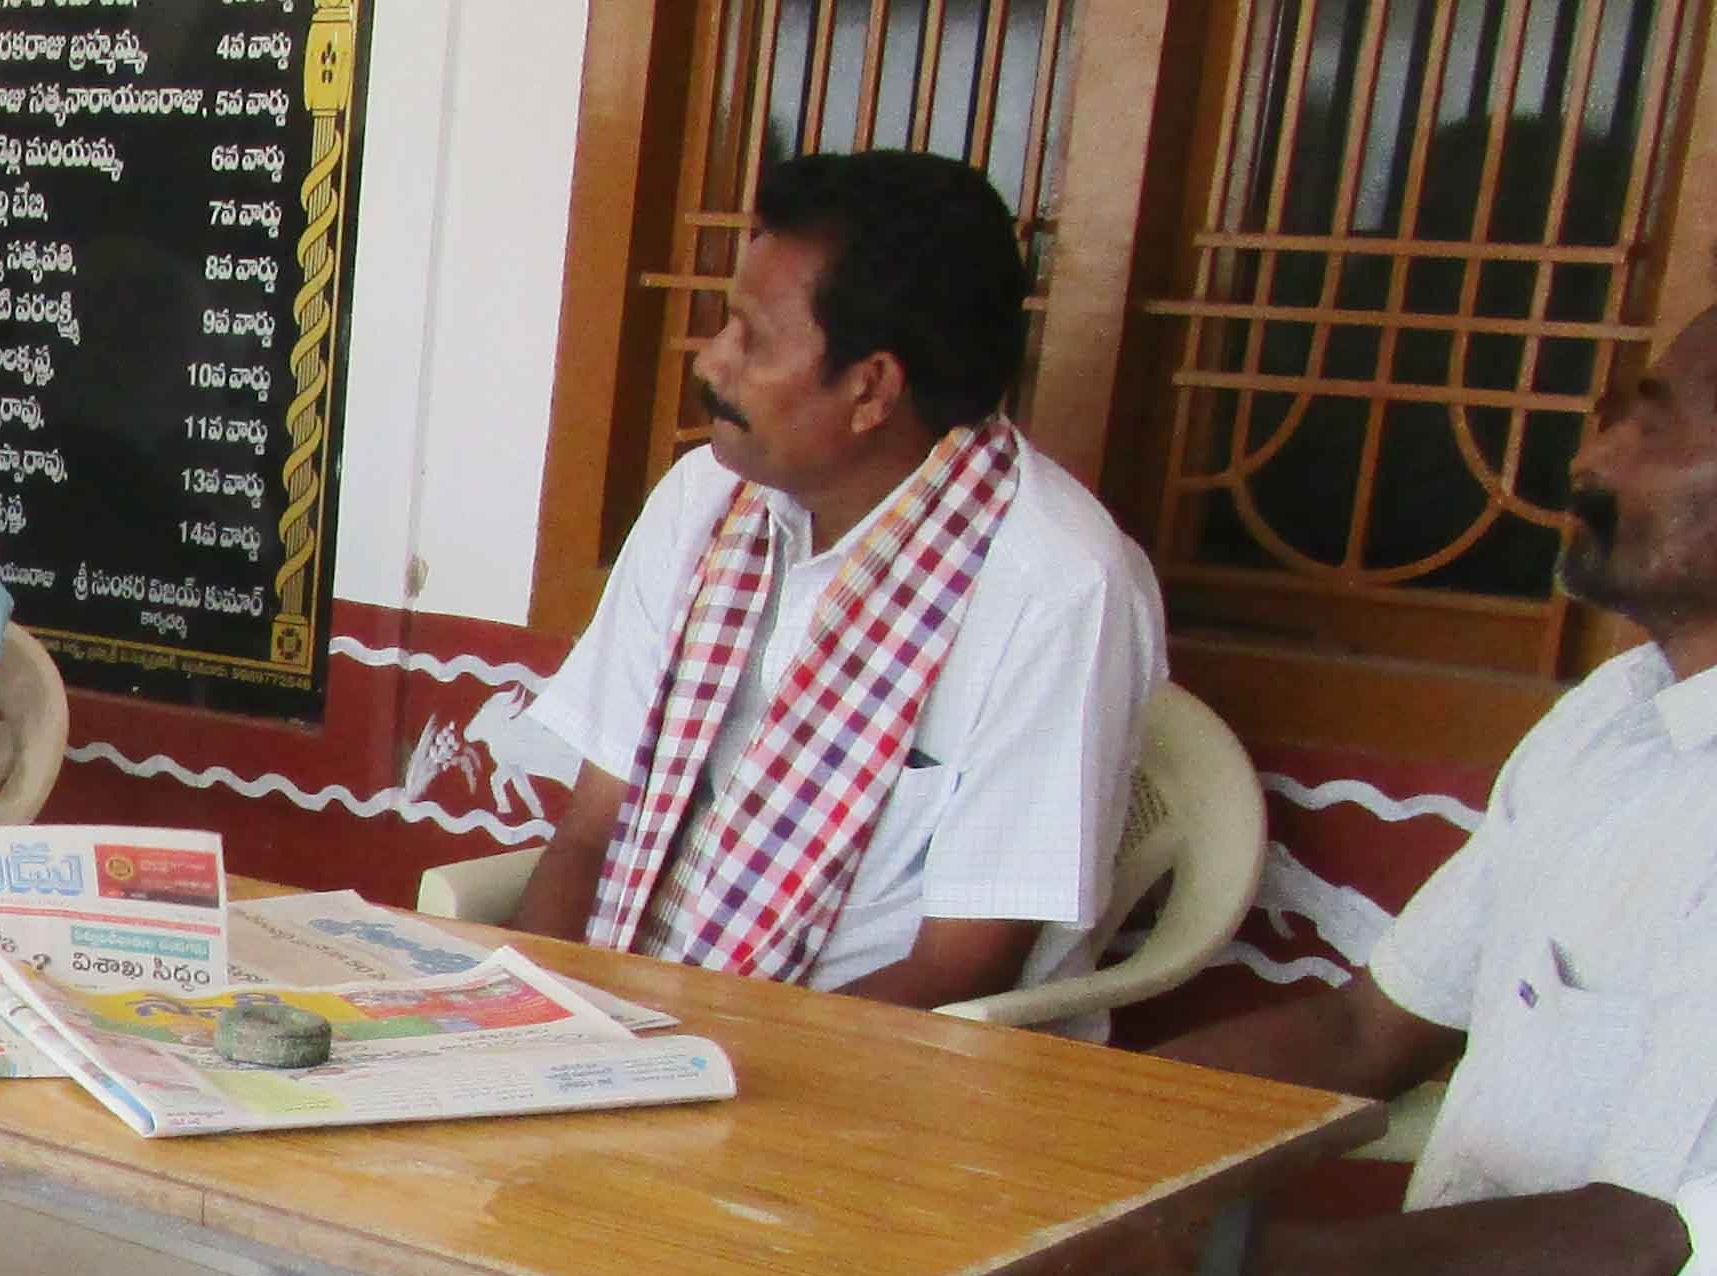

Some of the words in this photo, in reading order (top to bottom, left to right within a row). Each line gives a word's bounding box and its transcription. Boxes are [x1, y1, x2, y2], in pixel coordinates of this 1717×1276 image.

[217, 33, 245, 60] 4వ
[248, 31, 292, 70] వార్డు
[215, 89, 243, 116] 5వ
[246, 88, 289, 127] వార్డు
[211, 145, 239, 171] 6వ
[241, 144, 285, 183] వార్డు
[209, 200, 236, 226] 7వ
[238, 200, 282, 239] వార్డు
[205, 254, 233, 281] 8వ
[235, 254, 278, 293] వార్డు
[202, 308, 230, 335] 9వ
[232, 309, 276, 349] వార్డు
[187, 362, 226, 388] 10వ
[228, 364, 271, 402] వార్డు
[184, 415, 223, 441] 11వ
[226, 417, 268, 455] వార్డు
[181, 468, 221, 494] 13వ
[222, 470, 265, 509] వార్డు
[179, 521, 218, 547] 14వ
[220, 525, 261, 562] వార్డు
[73, 561, 88, 600] శ్రీ
[205, 584, 265, 618] కుమార్
[72, 951, 144, 981] విశాఖ
